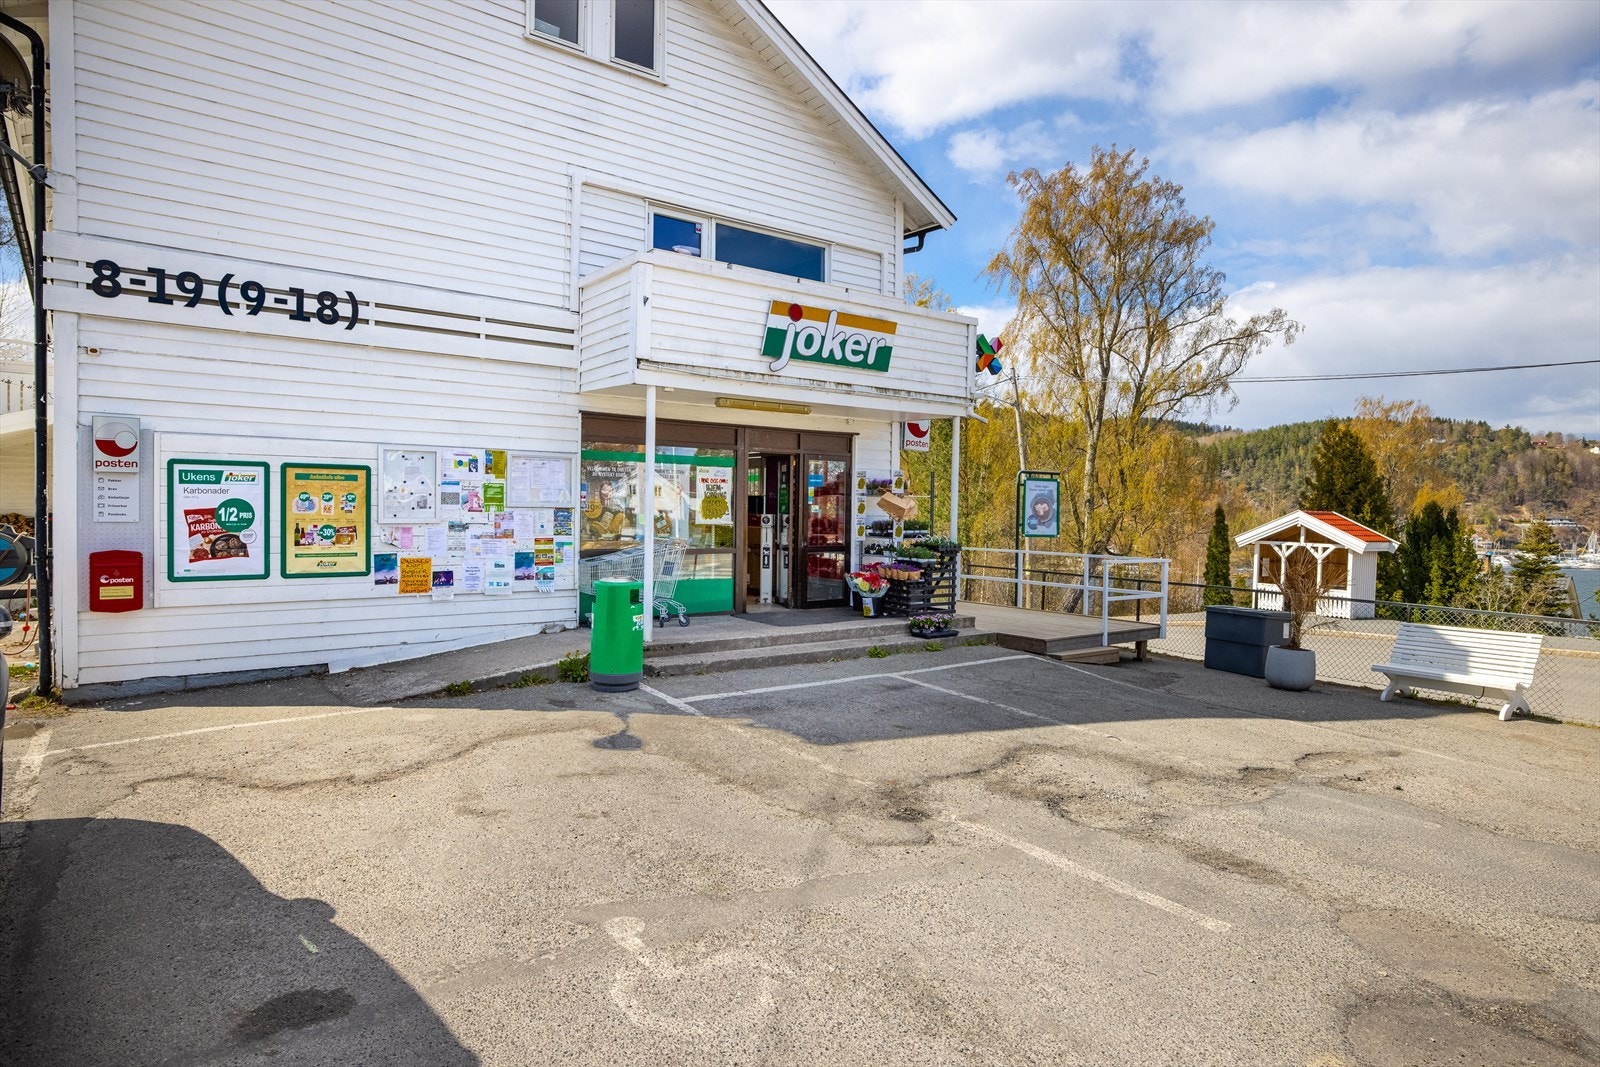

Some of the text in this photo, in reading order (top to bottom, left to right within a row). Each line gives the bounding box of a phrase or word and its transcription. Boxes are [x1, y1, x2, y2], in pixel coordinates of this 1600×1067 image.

[91, 259, 359, 330] 8-19 (9-18)
[769, 303, 887, 372] joker
[905, 439, 928, 448] posten
[95, 459, 138, 469] posten
[182, 472, 255, 483] Ukens joker
[183, 487, 230, 495] Karbonader
[218, 507, 238, 521] 1/2
